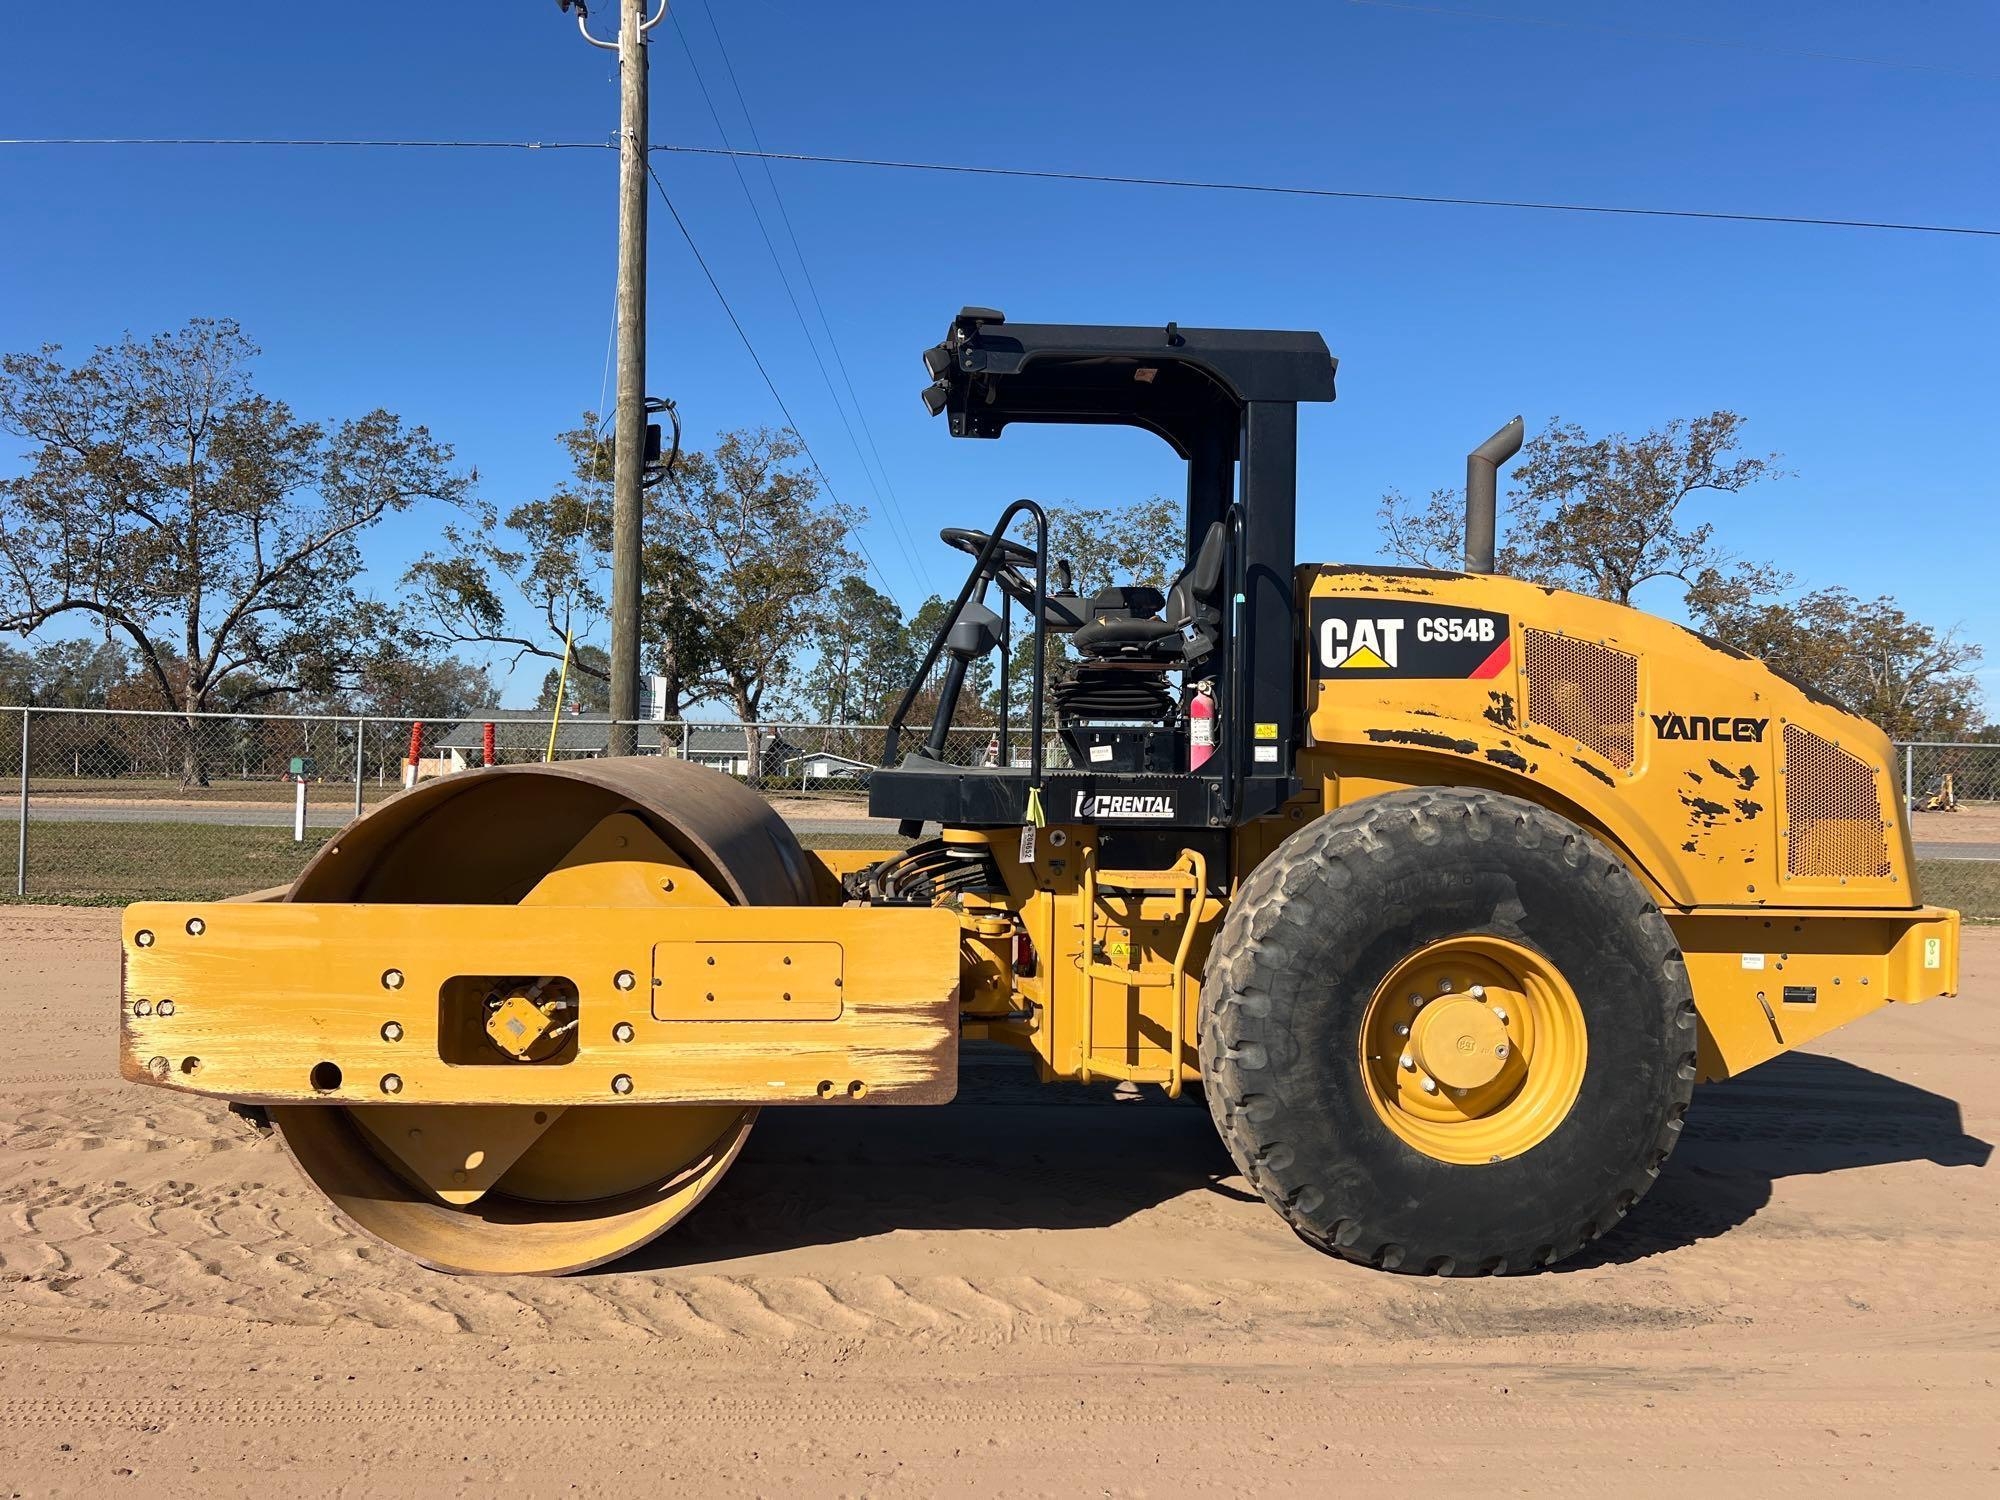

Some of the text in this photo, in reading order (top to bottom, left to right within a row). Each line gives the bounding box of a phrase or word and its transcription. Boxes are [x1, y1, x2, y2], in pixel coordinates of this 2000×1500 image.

[1320, 617, 1495, 668] CAT CS54B
[1650, 712, 1770, 742] YANCEY
[1110, 796, 1174, 813] RENTAL
